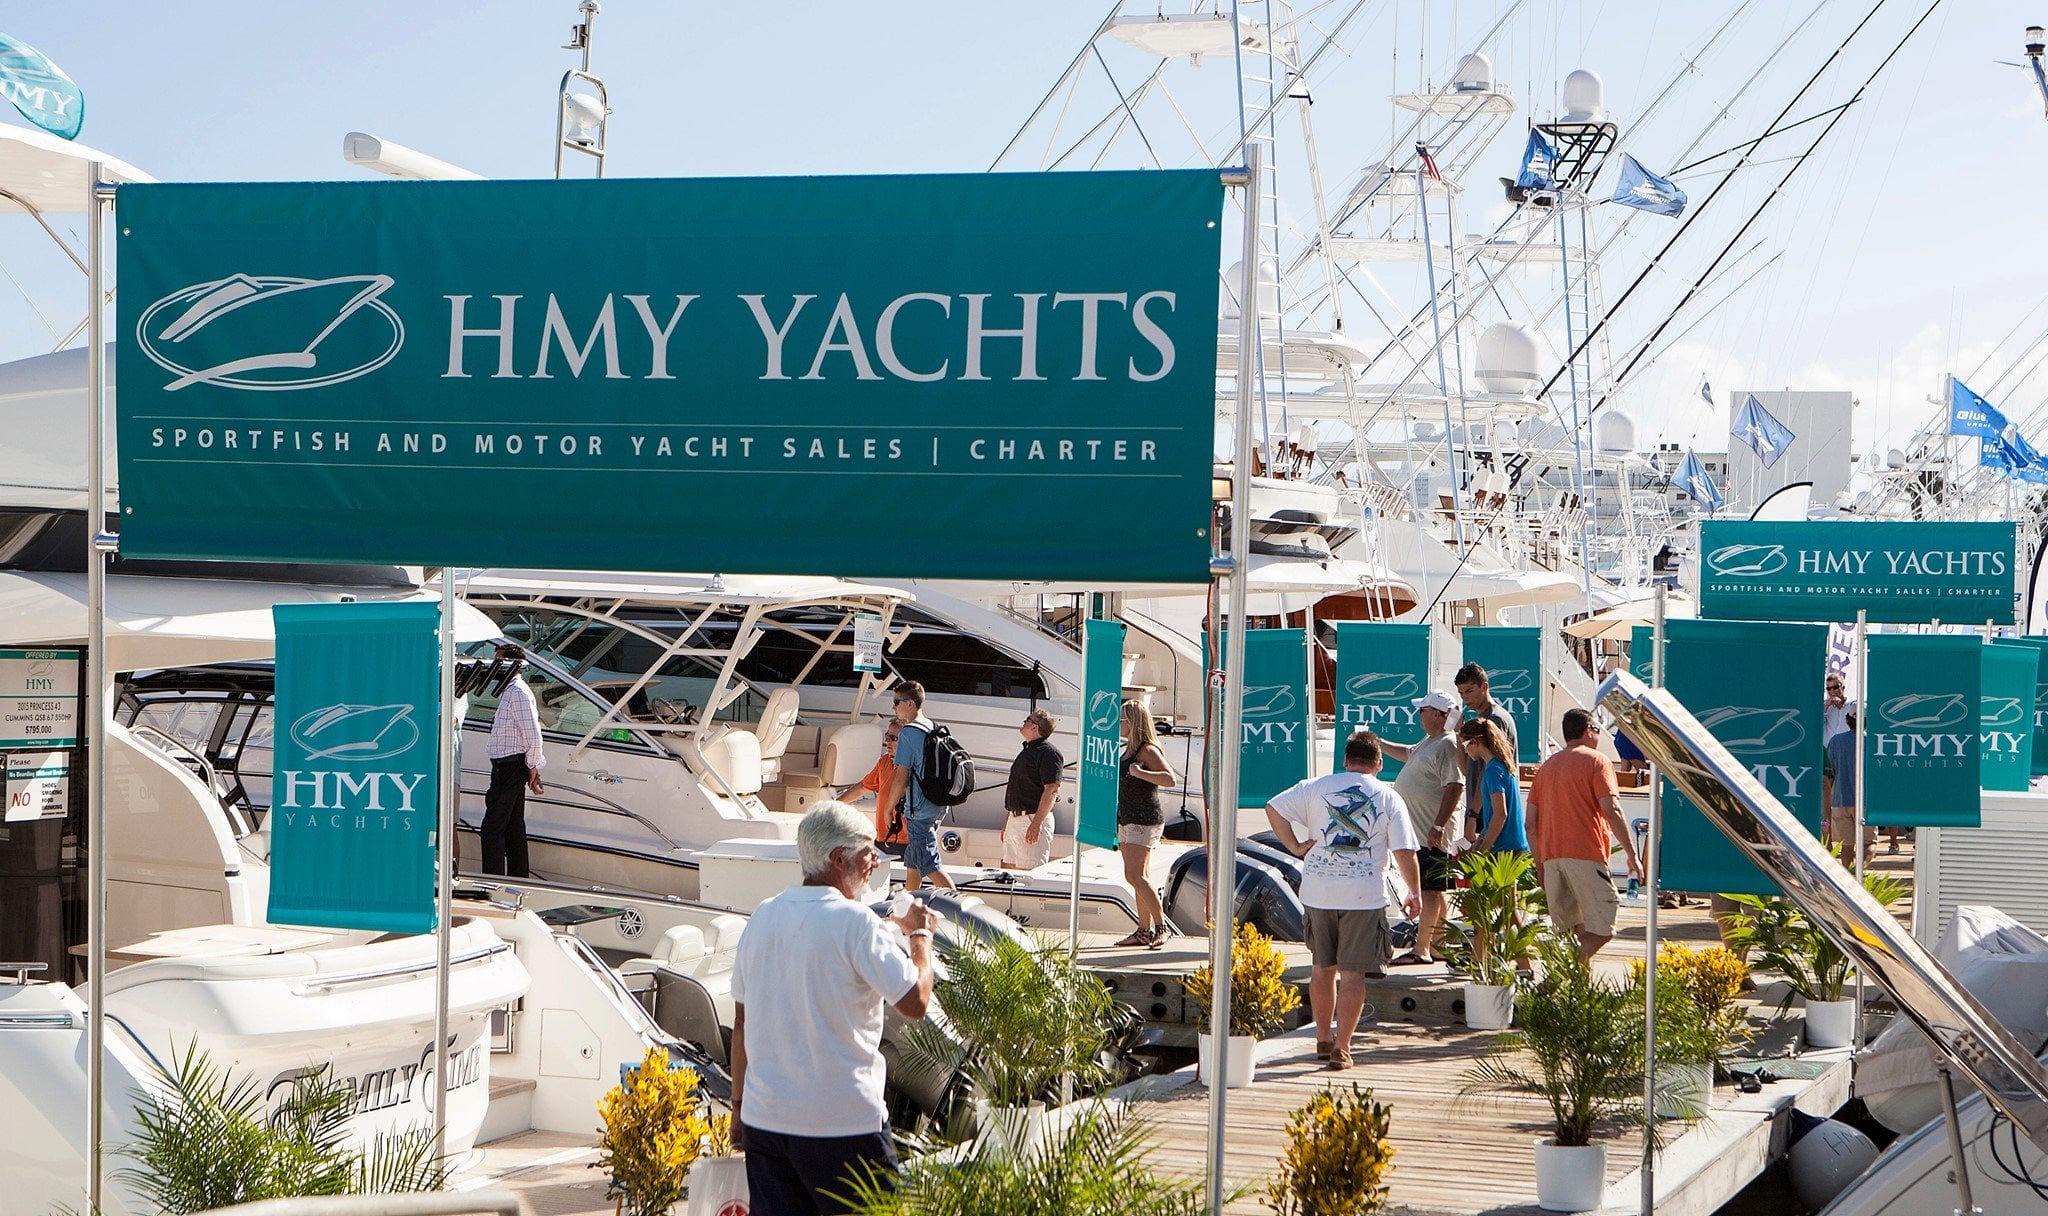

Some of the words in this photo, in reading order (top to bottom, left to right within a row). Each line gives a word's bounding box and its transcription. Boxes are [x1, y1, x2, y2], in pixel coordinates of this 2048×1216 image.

[0, 79, 76, 117] MY
[441, 293, 700, 381] HMY
[737, 290, 1176, 382] YACHTS
[152, 428, 349, 451] SPORTFISH
[377, 433, 447, 453] AND
[475, 434, 602, 455] MOTOR
[631, 436, 754, 457] YACHT
[783, 438, 901, 459] SALES
[970, 440, 1156, 461] CHARTER
[1798, 550, 1872, 574] HMY
[1884, 551, 2005, 576] YACHTS
[1711, 584, 1772, 592] SPORTFISH
[1807, 586, 1845, 594] MOTOR
[1948, 588, 2001, 596] CHARTER
[25, 651, 49, 659] OFFERED
[50, 651, 58, 659] BY
[26, 679, 55, 690] HMY
[17, 702, 29, 711] 2015
[30, 702, 54, 711] PRINCESS
[54, 701, 61, 711] 43
[1340, 703, 1420, 725] HMY
[5, 714, 33, 722] CUMMINS
[25, 725, 52, 735] $795,000
[1241, 721, 1301, 744] MY
[1085, 734, 1119, 768] HMY
[1873, 732, 1974, 758] HMY
[1981, 730, 2027, 754] MY
[1876, 758, 1964, 769] YACHTS
[11, 792, 31, 807] NO
[281, 770, 428, 812] HMY
[286, 813, 412, 831] YACHTS
